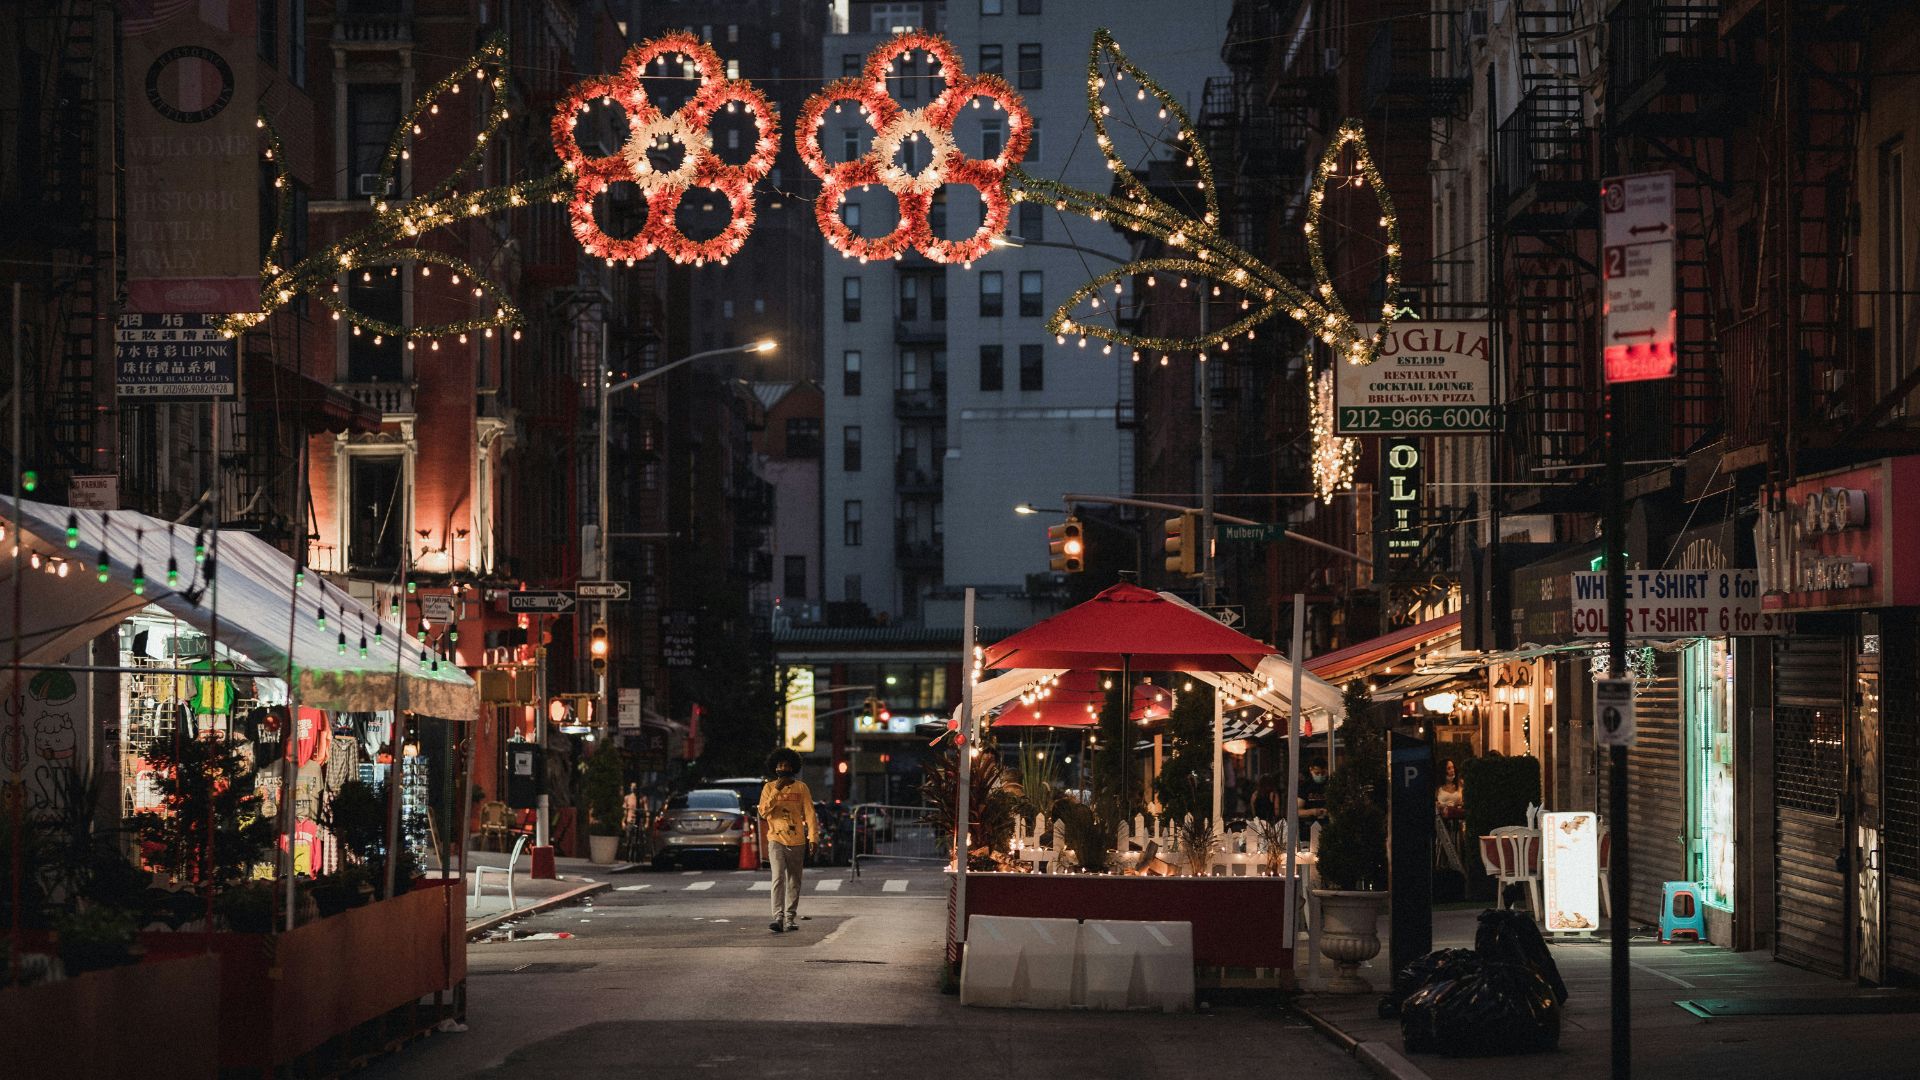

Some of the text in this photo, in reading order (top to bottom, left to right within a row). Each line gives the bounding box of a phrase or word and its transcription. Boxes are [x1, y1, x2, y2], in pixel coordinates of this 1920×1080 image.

[129, 136, 249, 156] WELCOME
[131, 192, 241, 211] HISTORIC
[132, 221, 214, 240] LITTLE
[133, 250, 201, 272] ITALY
[1609, 249, 1620, 276] 2
[182, 346, 228, 357] LIP-INK
[1370, 328, 1490, 362] UGLIA
[1397, 356, 1445, 366] EST.1919
[1384, 370, 1458, 380] RESTAURANT
[1369, 381, 1474, 391] COCKTAIL LOUNGE
[1367, 393, 1476, 404] BRICK-OVEN PIZZA
[81, 480, 108, 489] PARKING
[1226, 527, 1265, 541] Mulberry
[1575, 575, 1633, 600] WHE
[1638, 573, 1708, 599] T-SHIRT
[1719, 574, 1730, 599] 8
[1734, 573, 1759, 599] for
[513, 598, 569, 607] ONE WAY
[1573, 607, 1634, 633] COLR
[1638, 606, 1708, 633] T-SHIRT
[1719, 606, 1730, 631] 6
[1734, 606, 1758, 631] for
[176, 639, 208, 653] ATM
[1404, 766, 1419, 788] P
